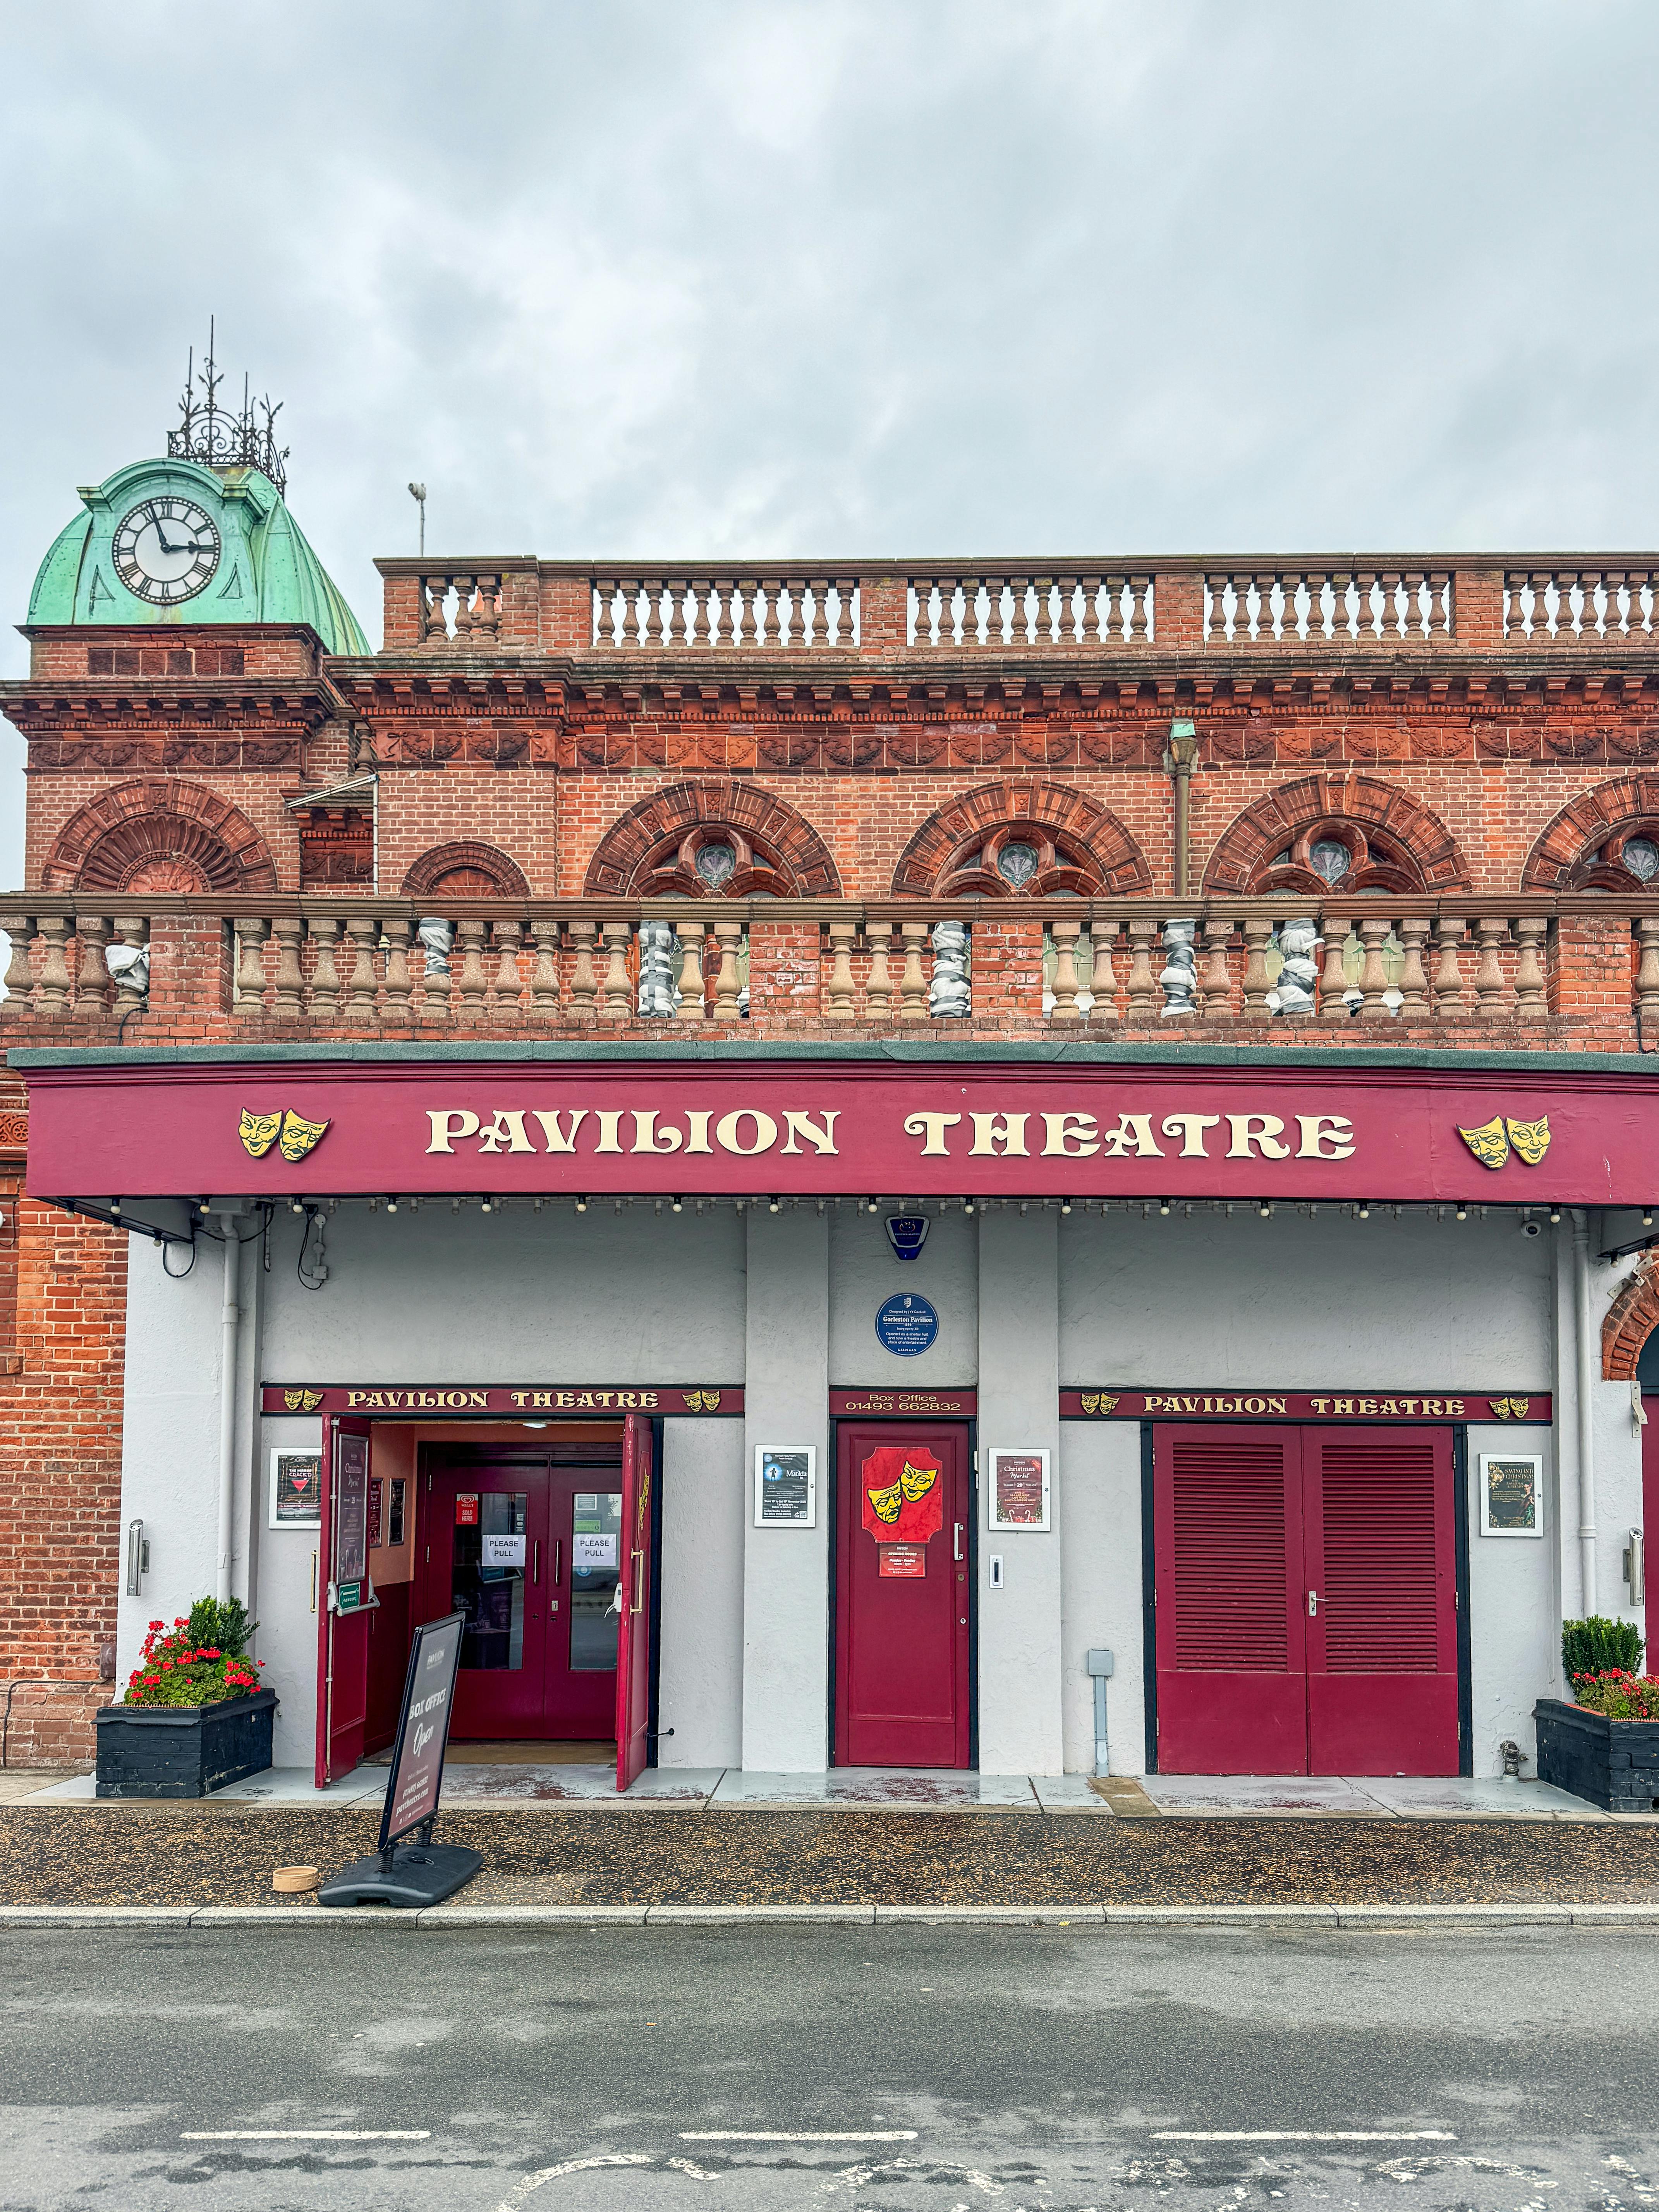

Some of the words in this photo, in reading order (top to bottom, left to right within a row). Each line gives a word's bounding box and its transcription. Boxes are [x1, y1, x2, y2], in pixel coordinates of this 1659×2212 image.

[161, 503, 172, 518] XII
[194, 523, 211, 536] II
[117, 546, 135, 555] IX
[193, 562, 211, 578] IIII
[425, 1109, 842, 1155] PAVILION
[903, 1112, 1357, 1160] THEATRE
[347, 1391, 488, 1407] PAVILION
[510, 1392, 658, 1408] THEATRE
[846, 1402, 893, 1410] 01493
[898, 1402, 961, 1411] 662832
[1143, 1396, 1288, 1414] PAVILION
[1310, 1399, 1465, 1415] THEATRE
[408, 1699, 425, 1721] BOX
[425, 1688, 447, 1712] OFFICE
[413, 1723, 434, 1757] Open
[396, 1787, 429, 1817] pavtheatre.com
